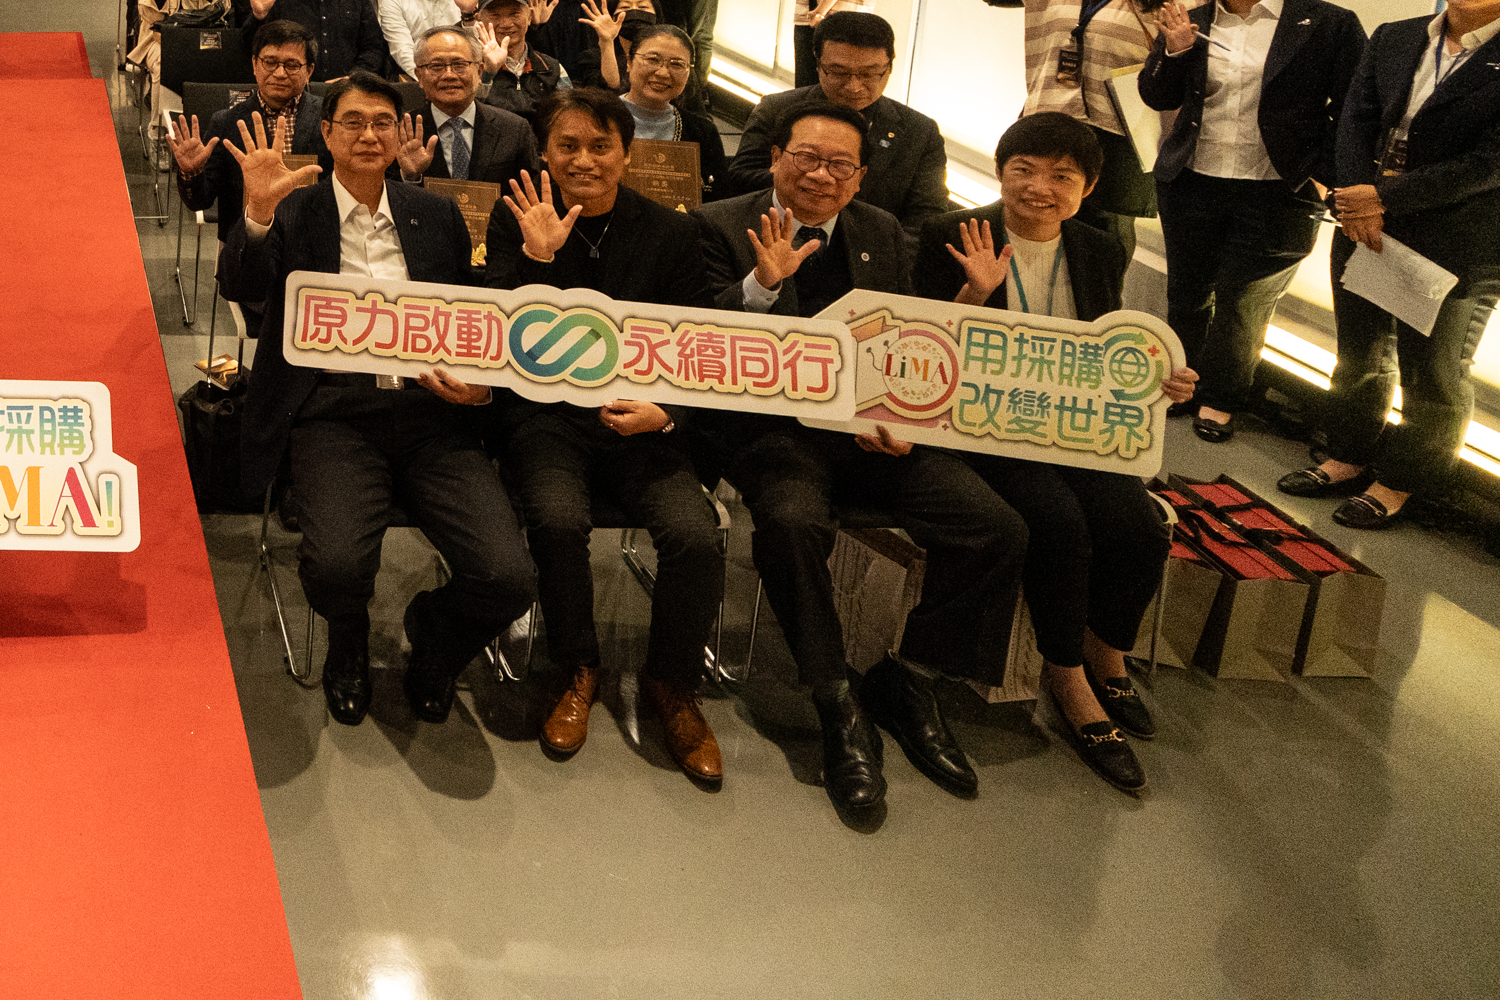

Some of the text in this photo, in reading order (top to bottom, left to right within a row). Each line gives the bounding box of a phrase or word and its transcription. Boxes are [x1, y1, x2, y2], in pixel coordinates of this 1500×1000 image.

[302, 295, 837, 395] 原力啟動 永續同行
[885, 353, 949, 385] LiMA
[963, 326, 1105, 390] 用採購
[959, 381, 1144, 450] 改變世界
